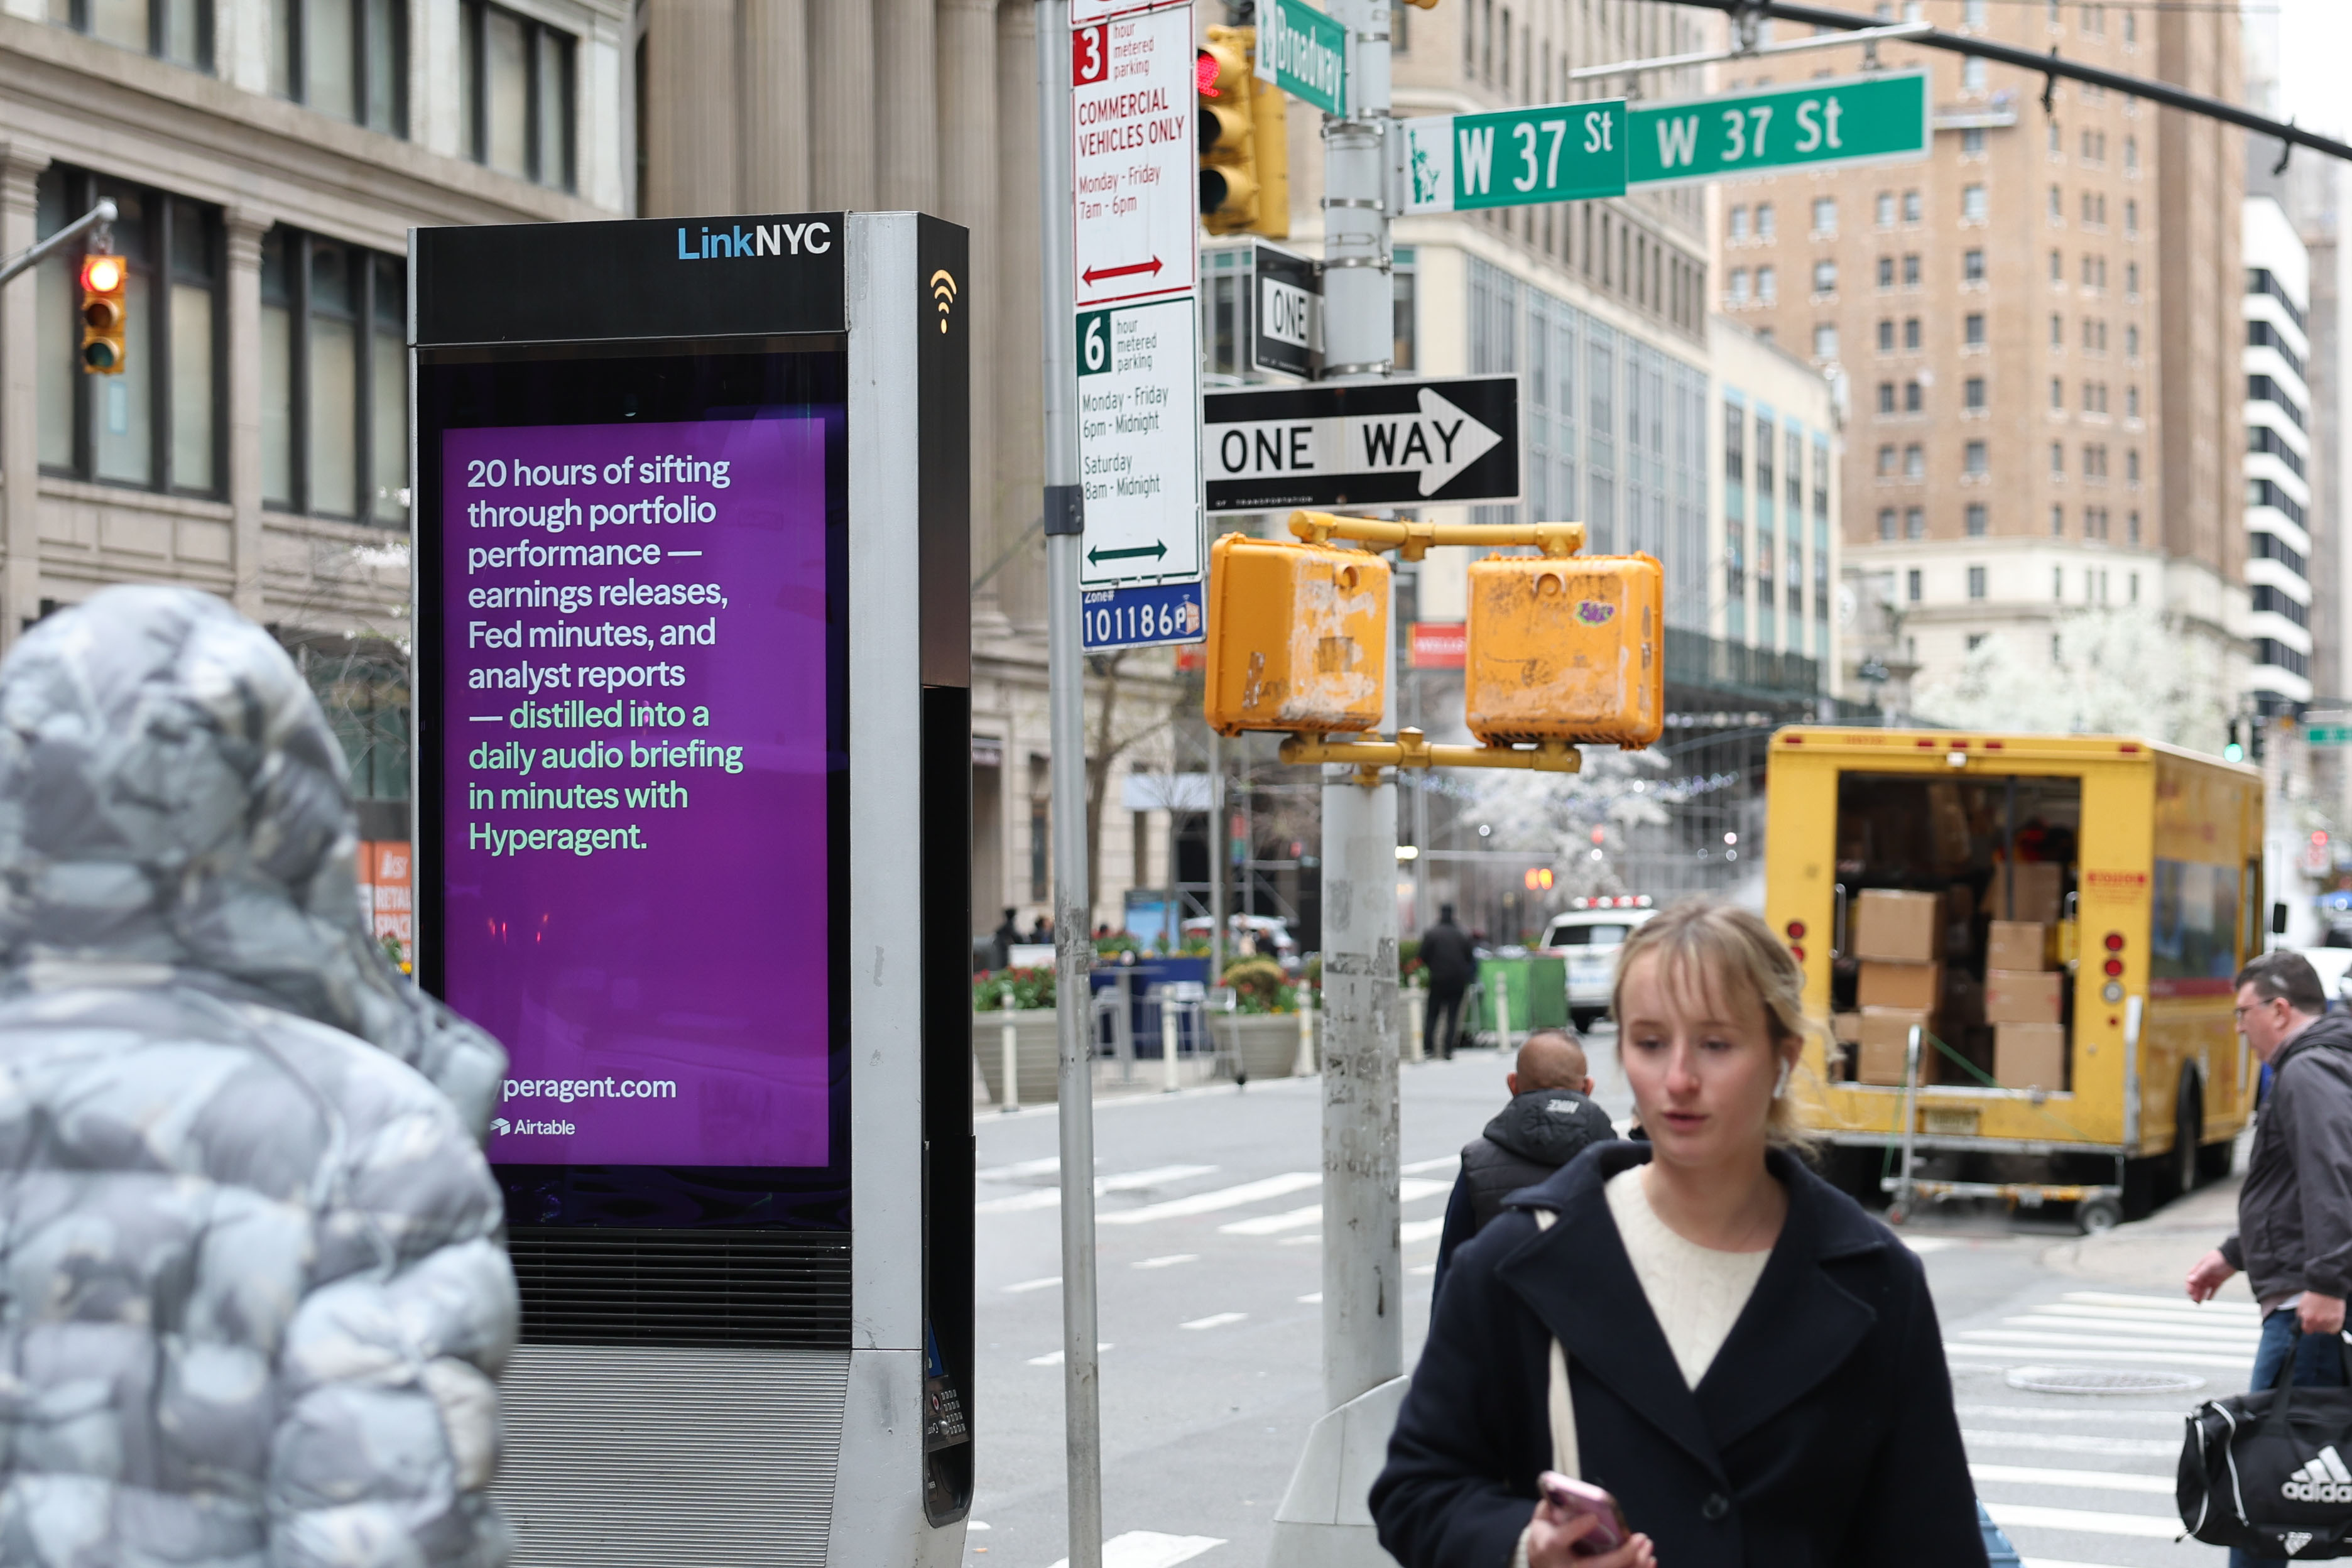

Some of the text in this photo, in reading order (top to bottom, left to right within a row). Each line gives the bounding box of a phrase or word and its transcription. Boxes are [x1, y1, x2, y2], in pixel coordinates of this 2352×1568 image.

[1113, 36, 1155, 58] metered
[1114, 23, 1135, 39] hour
[1081, 27, 1101, 80] 3
[1114, 58, 1150, 81] parking
[1277, 5, 1342, 115] Broadway
[1079, 87, 1168, 125] COMMERCIAL
[1079, 116, 1184, 157] VEHICLES ONLY
[1656, 96, 1843, 168] W 37 St
[1459, 111, 1613, 195] W 37 St
[1079, 172, 1119, 195] Monday
[1128, 163, 1162, 185] Friday
[1079, 202, 1102, 219] 7am
[1113, 195, 1137, 216] 6pm
[678, 222, 831, 259] LinkNYC
[1116, 319, 1138, 334] hour
[1273, 289, 1307, 340] ONE
[1084, 316, 1104, 371] 6
[1117, 334, 1157, 352] metered
[1117, 353, 1153, 374] parking
[1082, 390, 1124, 413] Monday
[1135, 384, 1168, 407] Friday
[1084, 419, 1106, 441] 6pm
[1116, 410, 1159, 435] Midnight
[1084, 452, 1132, 475] Saturday
[1221, 419, 1464, 473] ONE WAY
[467, 454, 731, 489] 20 hours of sifting
[1086, 481, 1107, 500] 8am
[1116, 474, 1161, 498] Midnight
[467, 495, 717, 533] through portfolio
[469, 538, 661, 575] performance
[468, 577, 728, 614] earnings releases,
[1084, 590, 1116, 604] Zone#
[469, 616, 716, 651] Fed minutes, and
[1085, 602, 1173, 643] 101186
[469, 660, 685, 695] analyst reports
[509, 699, 623, 729] distilled
[629, 699, 686, 727] into
[692, 705, 709, 727] a
[469, 739, 744, 776] daily audio briefing
[469, 780, 688, 810] in minutes with
[470, 822, 647, 857] Hyperagent.
[494, 1076, 676, 1103] peragent.com
[514, 1119, 575, 1135] Airtable
[2281, 1479, 2352, 1503] adida
